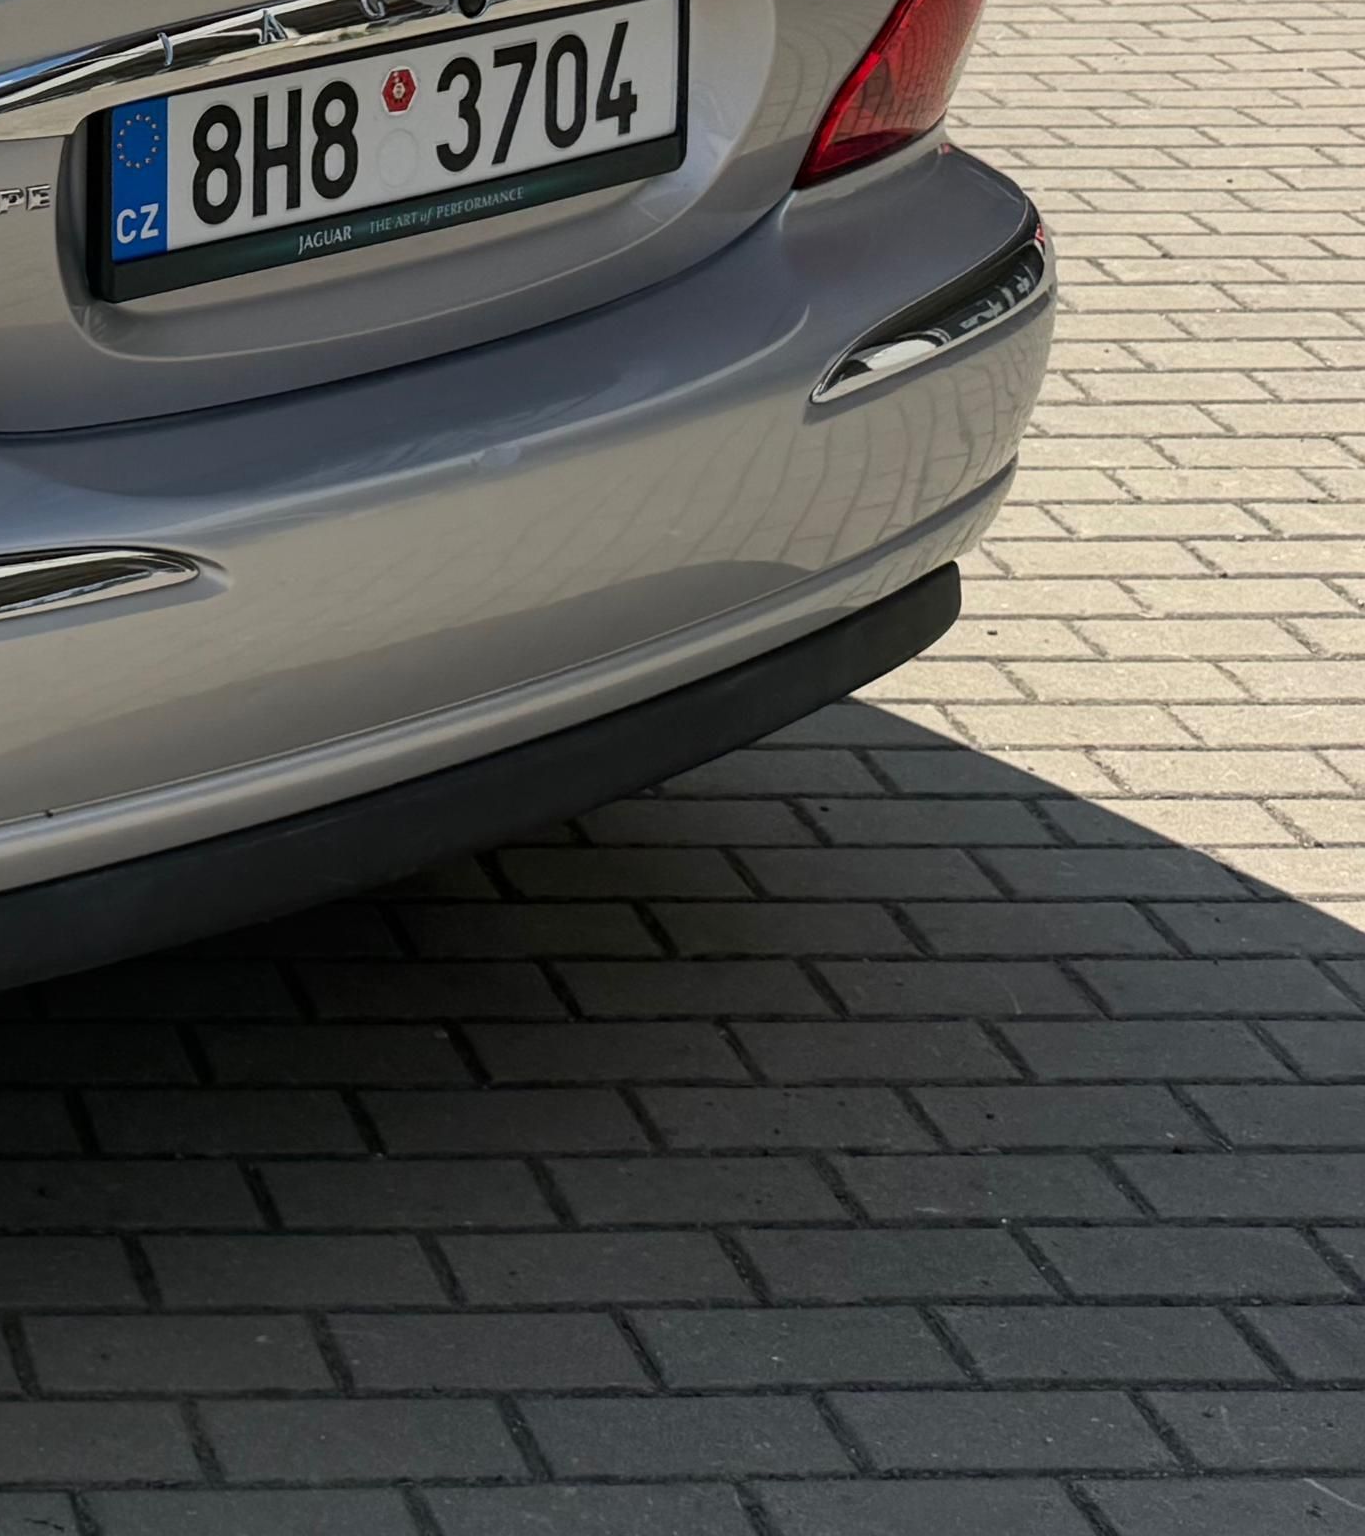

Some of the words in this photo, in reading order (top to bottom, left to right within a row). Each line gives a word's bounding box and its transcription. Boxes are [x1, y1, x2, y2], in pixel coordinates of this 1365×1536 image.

[191, 80, 360, 225] 8H8
[435, 20, 639, 174] 3704
[115, 202, 160, 245] CZ
[298, 225, 352, 255] JAGUAR
[370, 218, 393, 234] THE
[395, 211, 419, 230] ART
[420, 208, 434, 227] of
[436, 186, 524, 218] PERFORMANCE
